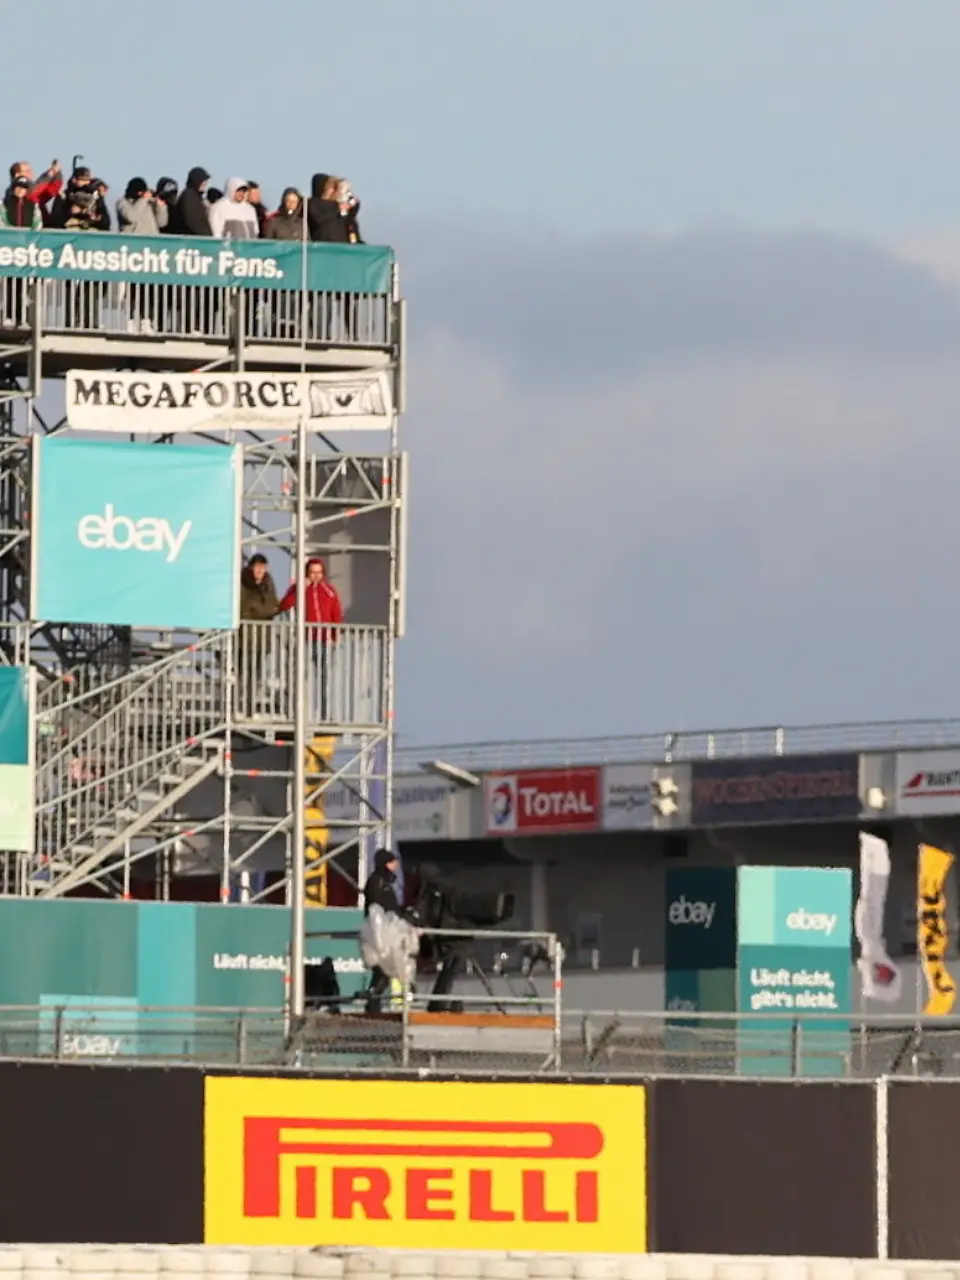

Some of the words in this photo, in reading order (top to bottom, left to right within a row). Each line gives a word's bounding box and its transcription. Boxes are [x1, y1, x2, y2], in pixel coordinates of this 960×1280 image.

[57, 246, 170, 274] Aussicht
[175, 248, 212, 276] für
[218, 252, 284, 279] Fans.
[72, 378, 301, 408] MEGAFORCE
[77, 503, 192, 562] ebay
[519, 788, 594, 816] TOTAL
[668, 896, 717, 928] ebay
[786, 907, 838, 936] ebay
[750, 968, 790, 988] Läuft
[792, 969, 835, 990] nicht,
[750, 989, 793, 1011] gibt's
[794, 991, 838, 1010] nicht.
[243, 1116, 605, 1223] PIRELLI
